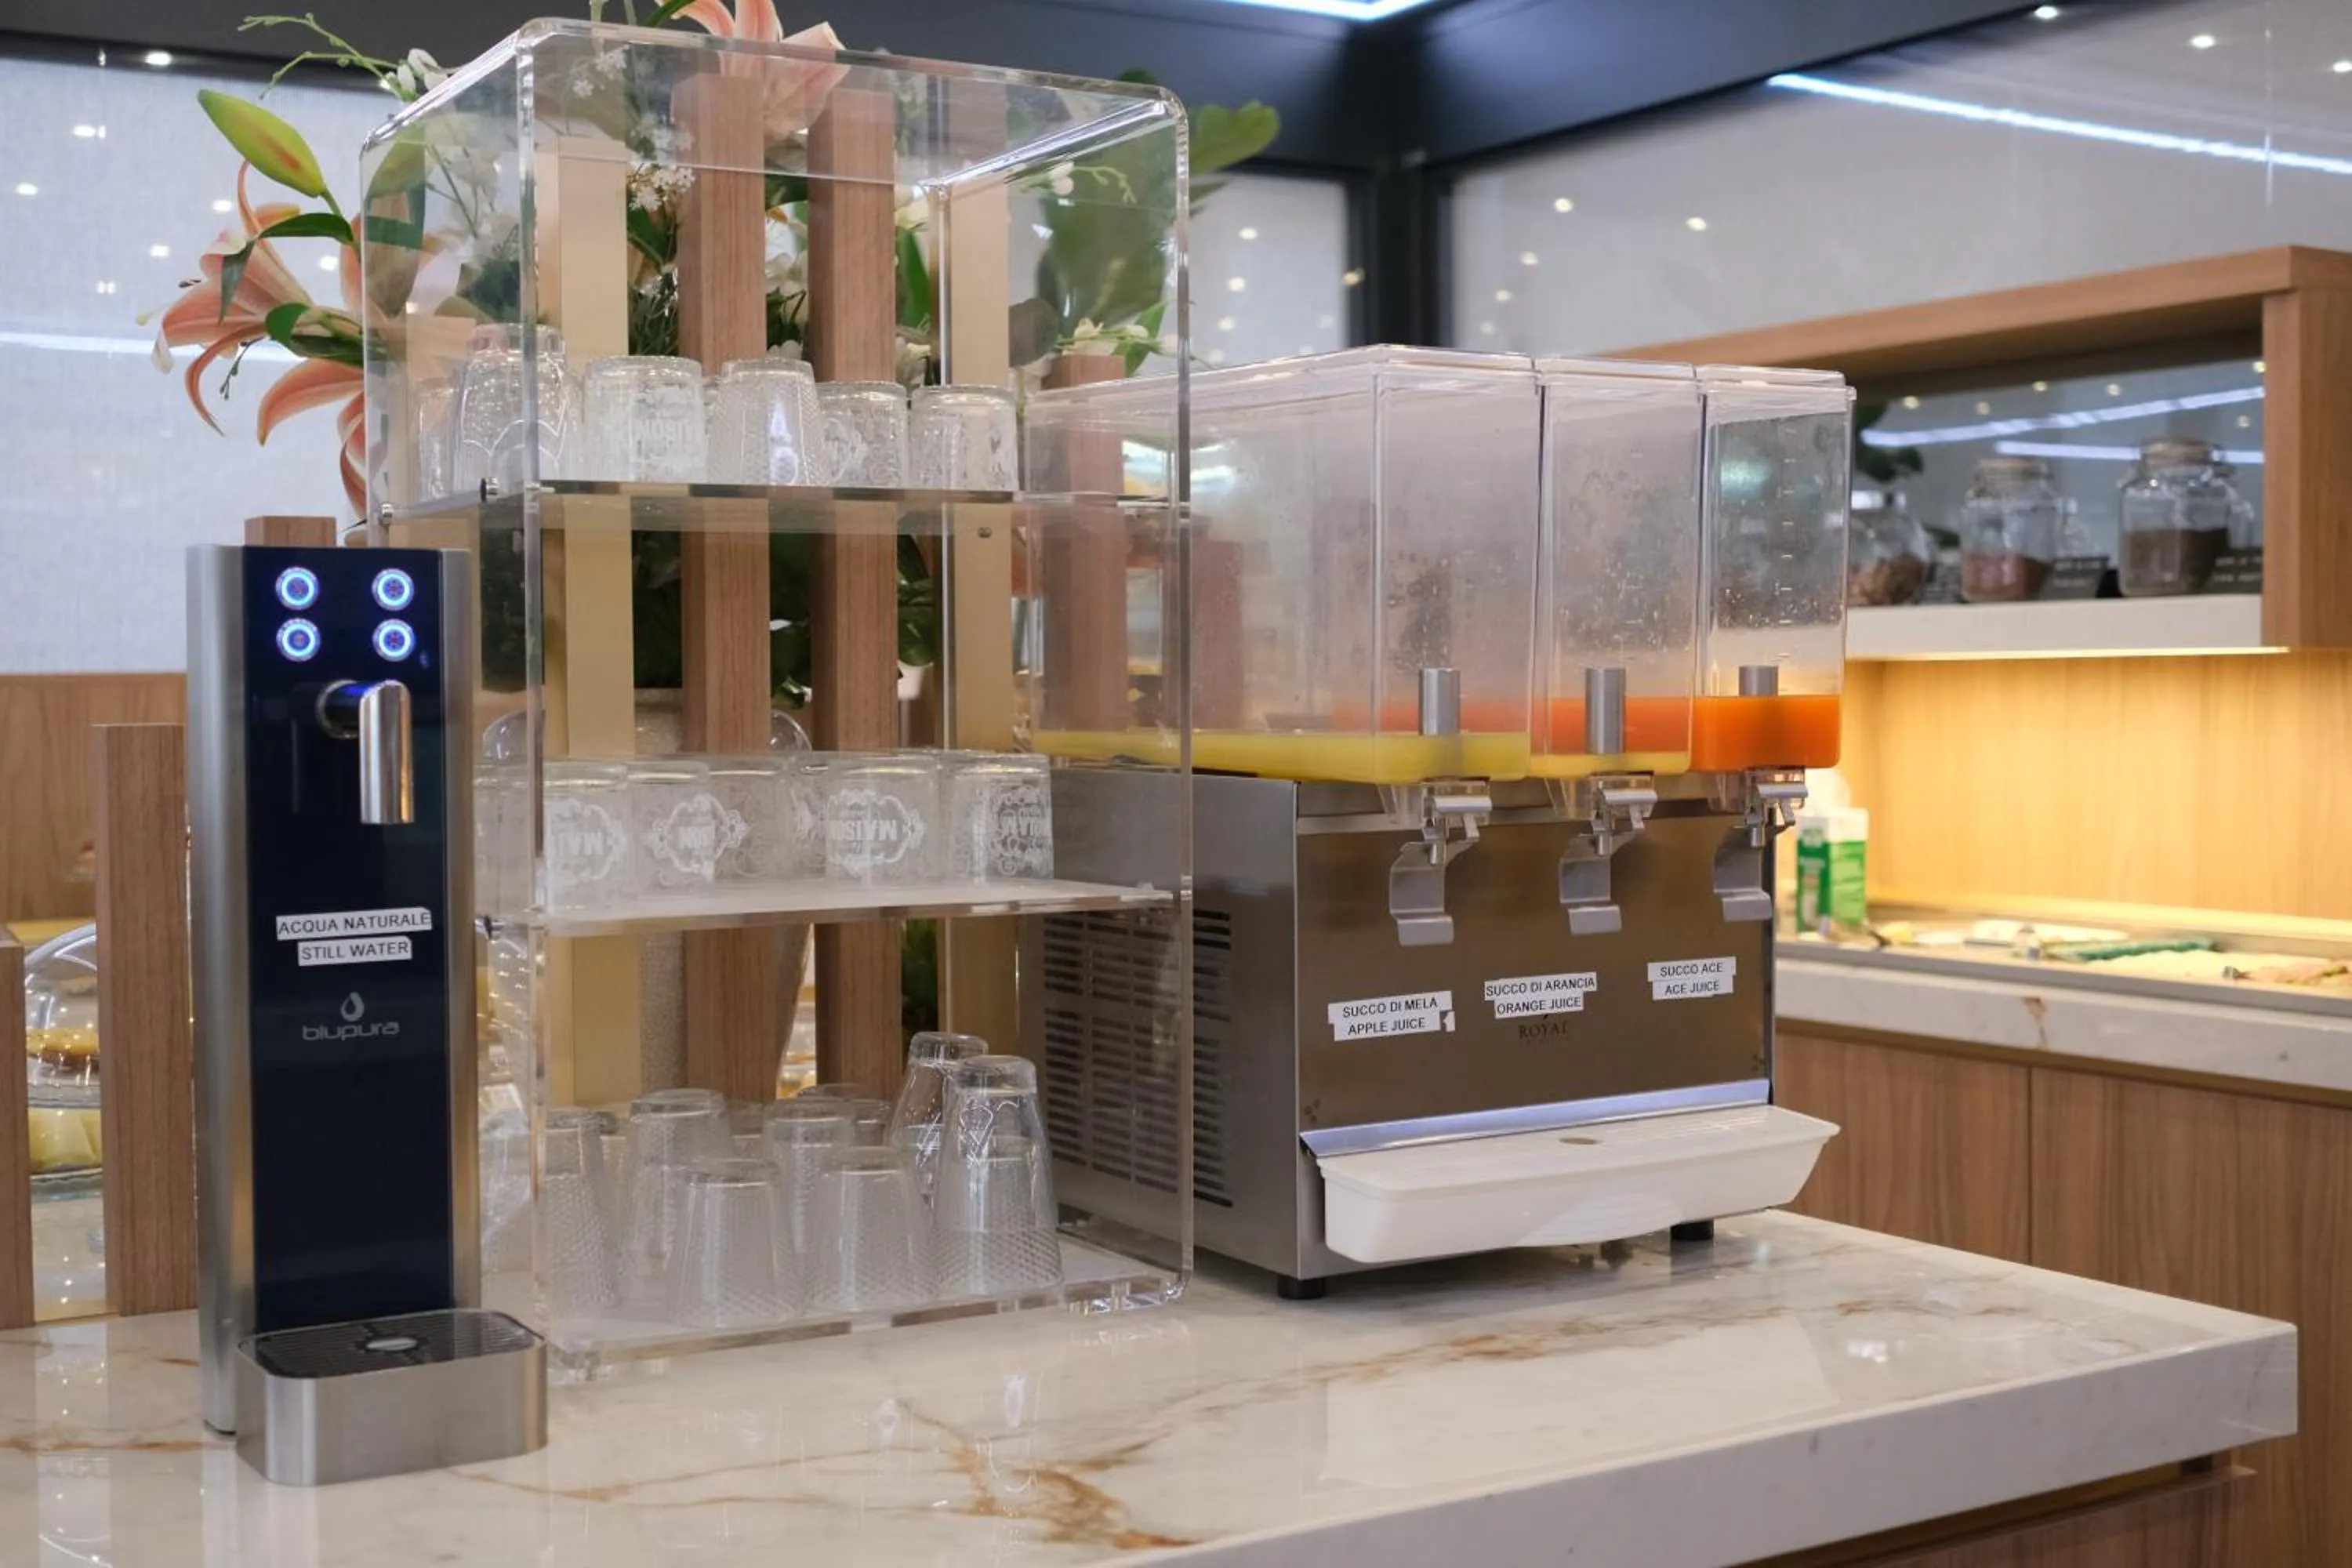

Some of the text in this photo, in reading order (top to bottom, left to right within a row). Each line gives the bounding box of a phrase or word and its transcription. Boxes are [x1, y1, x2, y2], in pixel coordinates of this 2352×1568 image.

[278, 912, 431, 935] ACQUA NATURALE
[300, 941, 409, 960] STILL WATER
[1660, 962, 1724, 978] SUCCO ACE
[1486, 978, 1595, 996] SUCCO DI ARANCIA
[1664, 980, 1720, 996] ACE JUICE
[1342, 996, 1439, 1018] SUCCO DI MELA
[1497, 996, 1582, 1014] ORANGE JUICE
[301, 1021, 401, 1041] blupura
[1347, 1017, 1426, 1036] APPLE JUICE
